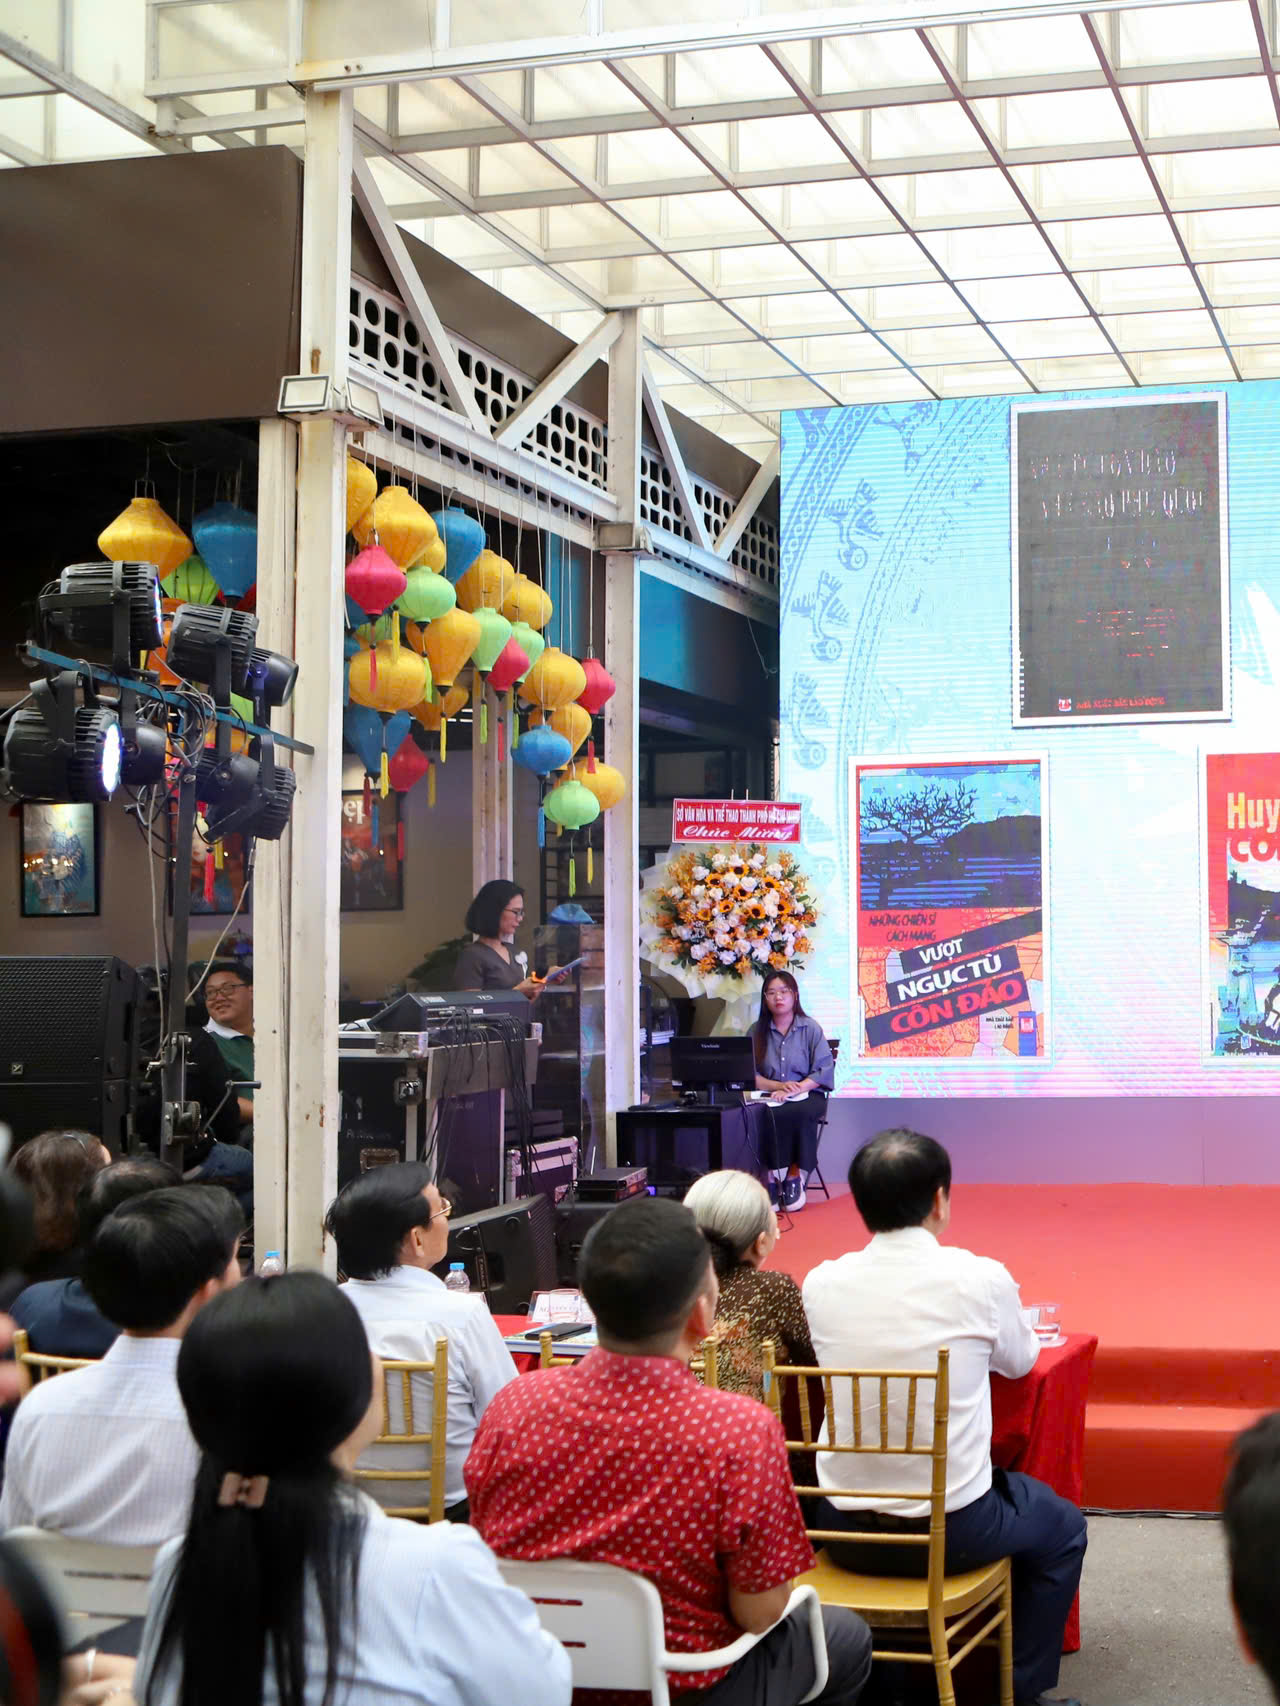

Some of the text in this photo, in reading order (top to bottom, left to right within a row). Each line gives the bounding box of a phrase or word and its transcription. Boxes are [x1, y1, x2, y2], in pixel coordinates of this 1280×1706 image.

[683, 825, 730, 838] Chúc
[919, 938, 963, 964] VƯỢT
[897, 953, 1002, 1001] NGỤC TÙ
[890, 1000, 954, 1033] CÔN
[955, 977, 1023, 1014] ĐẢO
